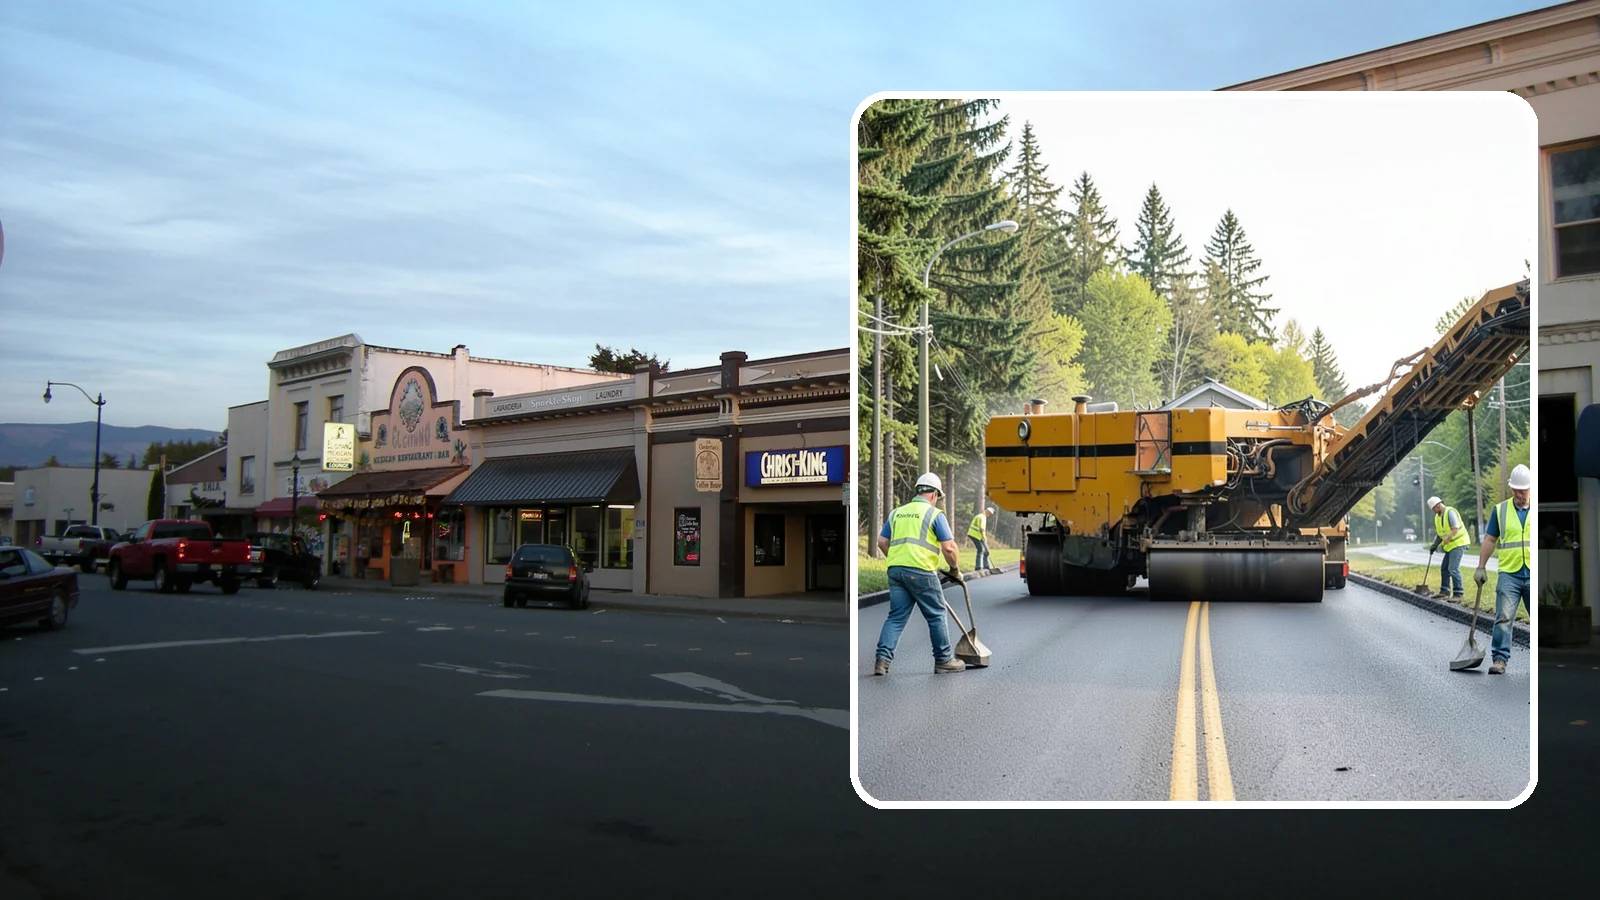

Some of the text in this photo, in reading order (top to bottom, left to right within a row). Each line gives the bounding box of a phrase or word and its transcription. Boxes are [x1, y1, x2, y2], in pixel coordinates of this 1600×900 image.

[595, 389, 624, 400] LAUNDRY
[493, 402, 523, 413] LAVANDERIA
[397, 451, 433, 462] RESTAURANT
[437, 450, 450, 459] BAR
[760, 450, 828, 478] CHRIST KING
